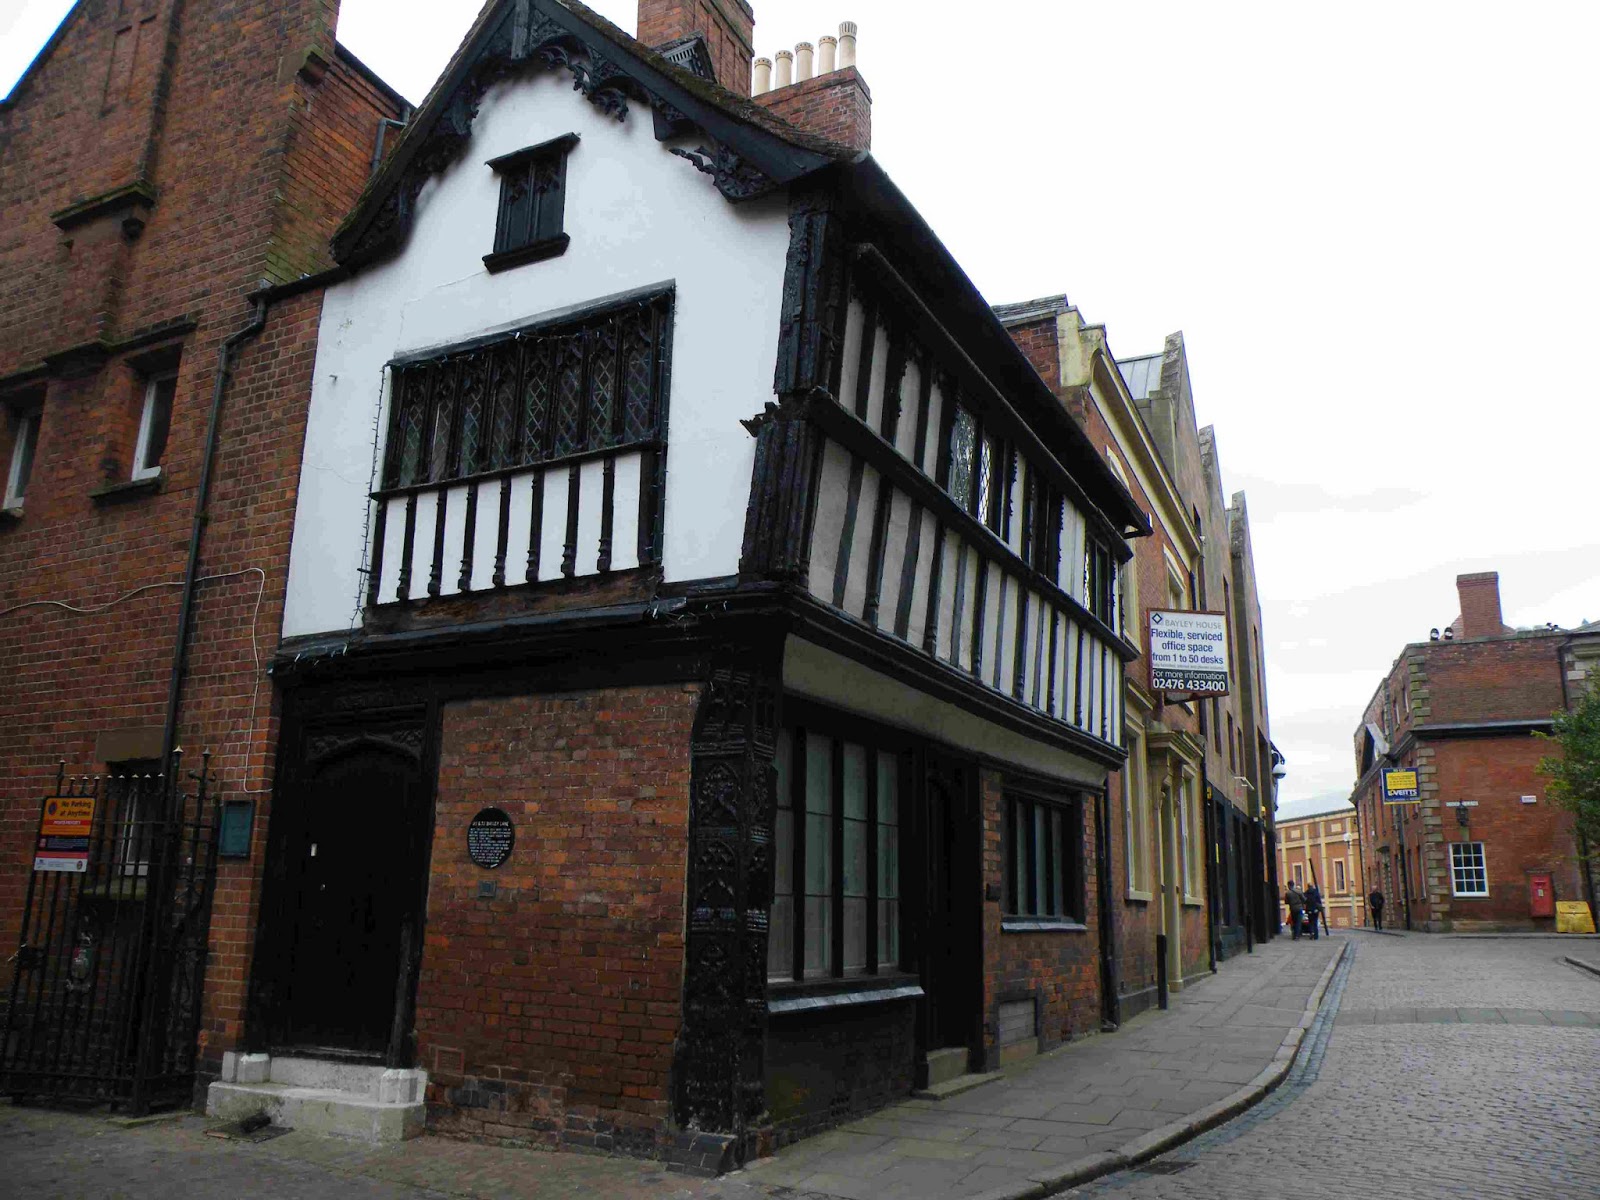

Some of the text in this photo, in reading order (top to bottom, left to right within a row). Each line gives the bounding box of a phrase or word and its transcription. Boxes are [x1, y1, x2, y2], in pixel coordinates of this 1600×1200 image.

[1165, 619, 1222, 630] BAYLEY HOUSE
[1151, 628, 1223, 641] Flexible, serviced
[1162, 641, 1213, 653] office space
[1152, 652, 1224, 664] from 1 to 50 desks
[1152, 669, 1225, 680] For more information
[1153, 678, 1226, 692] 02476 433400
